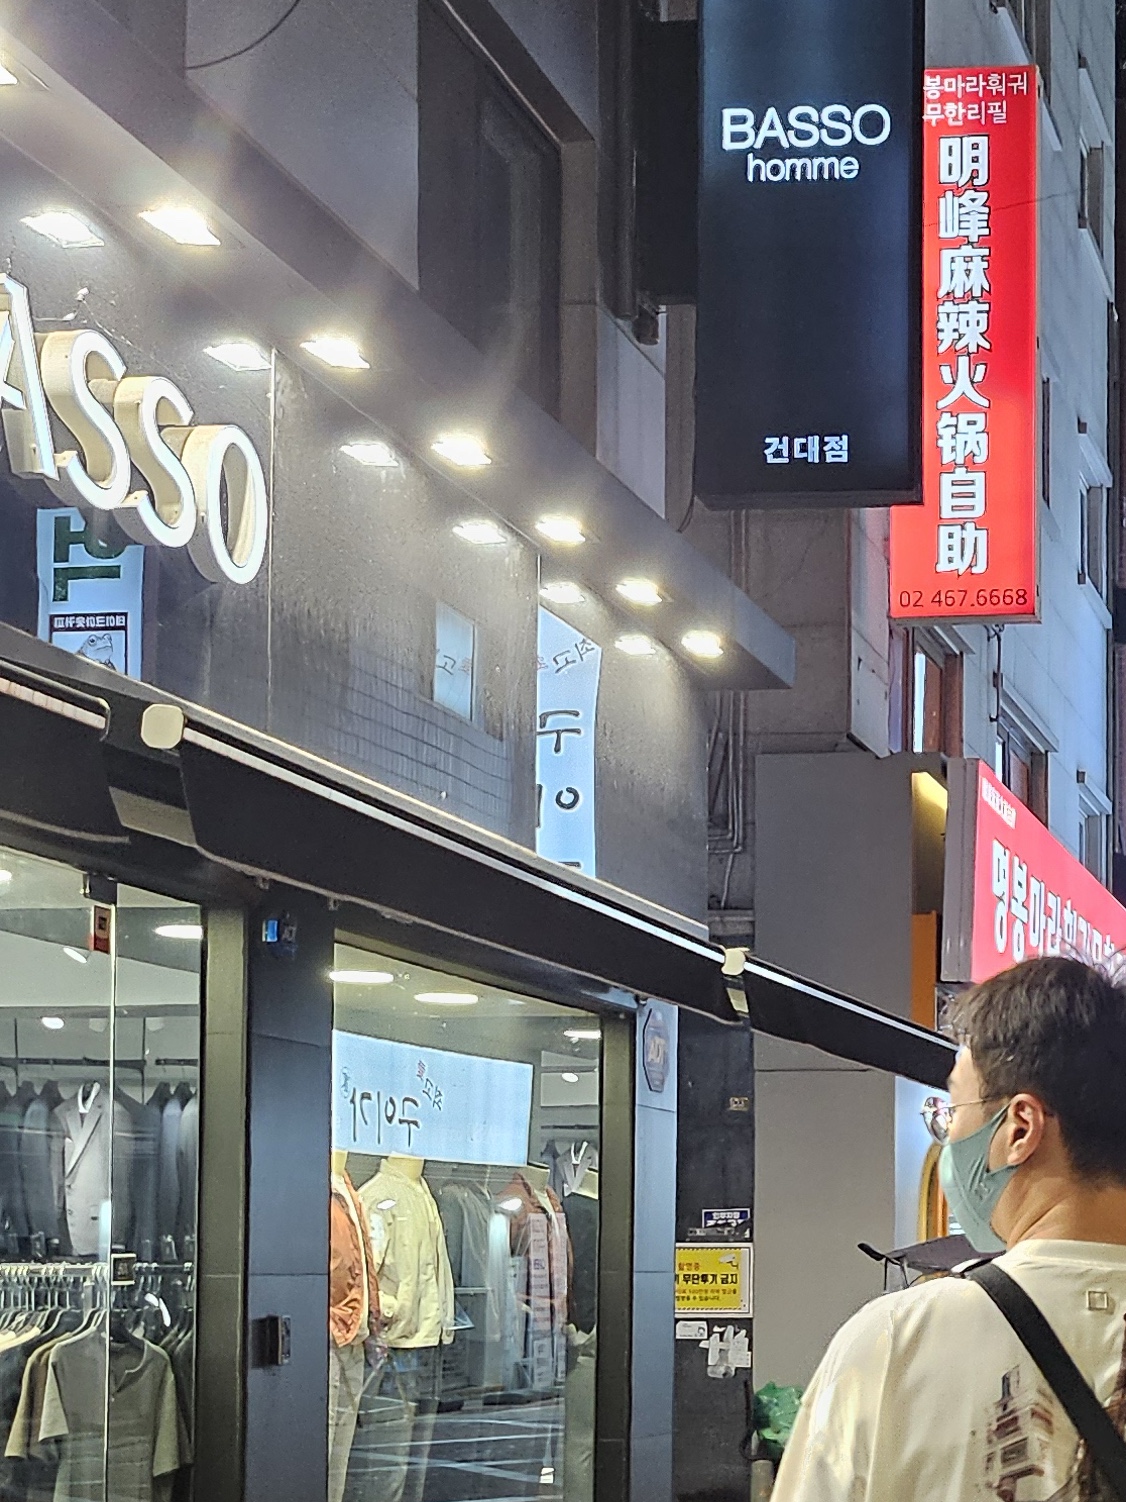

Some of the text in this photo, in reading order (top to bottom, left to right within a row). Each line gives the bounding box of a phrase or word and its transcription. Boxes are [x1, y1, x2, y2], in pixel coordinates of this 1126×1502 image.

[922, 100, 1008, 127] 무한리필
[721, 104, 891, 152] BASSO
[746, 154, 860, 182] homme
[935, 134, 991, 577] 明峰麻辣火锅自助
[763, 434, 850, 465] 건대점
[899, 588, 1028, 608] 02 467.6668
[682, 1273, 738, 1285] 무단투기 금지
